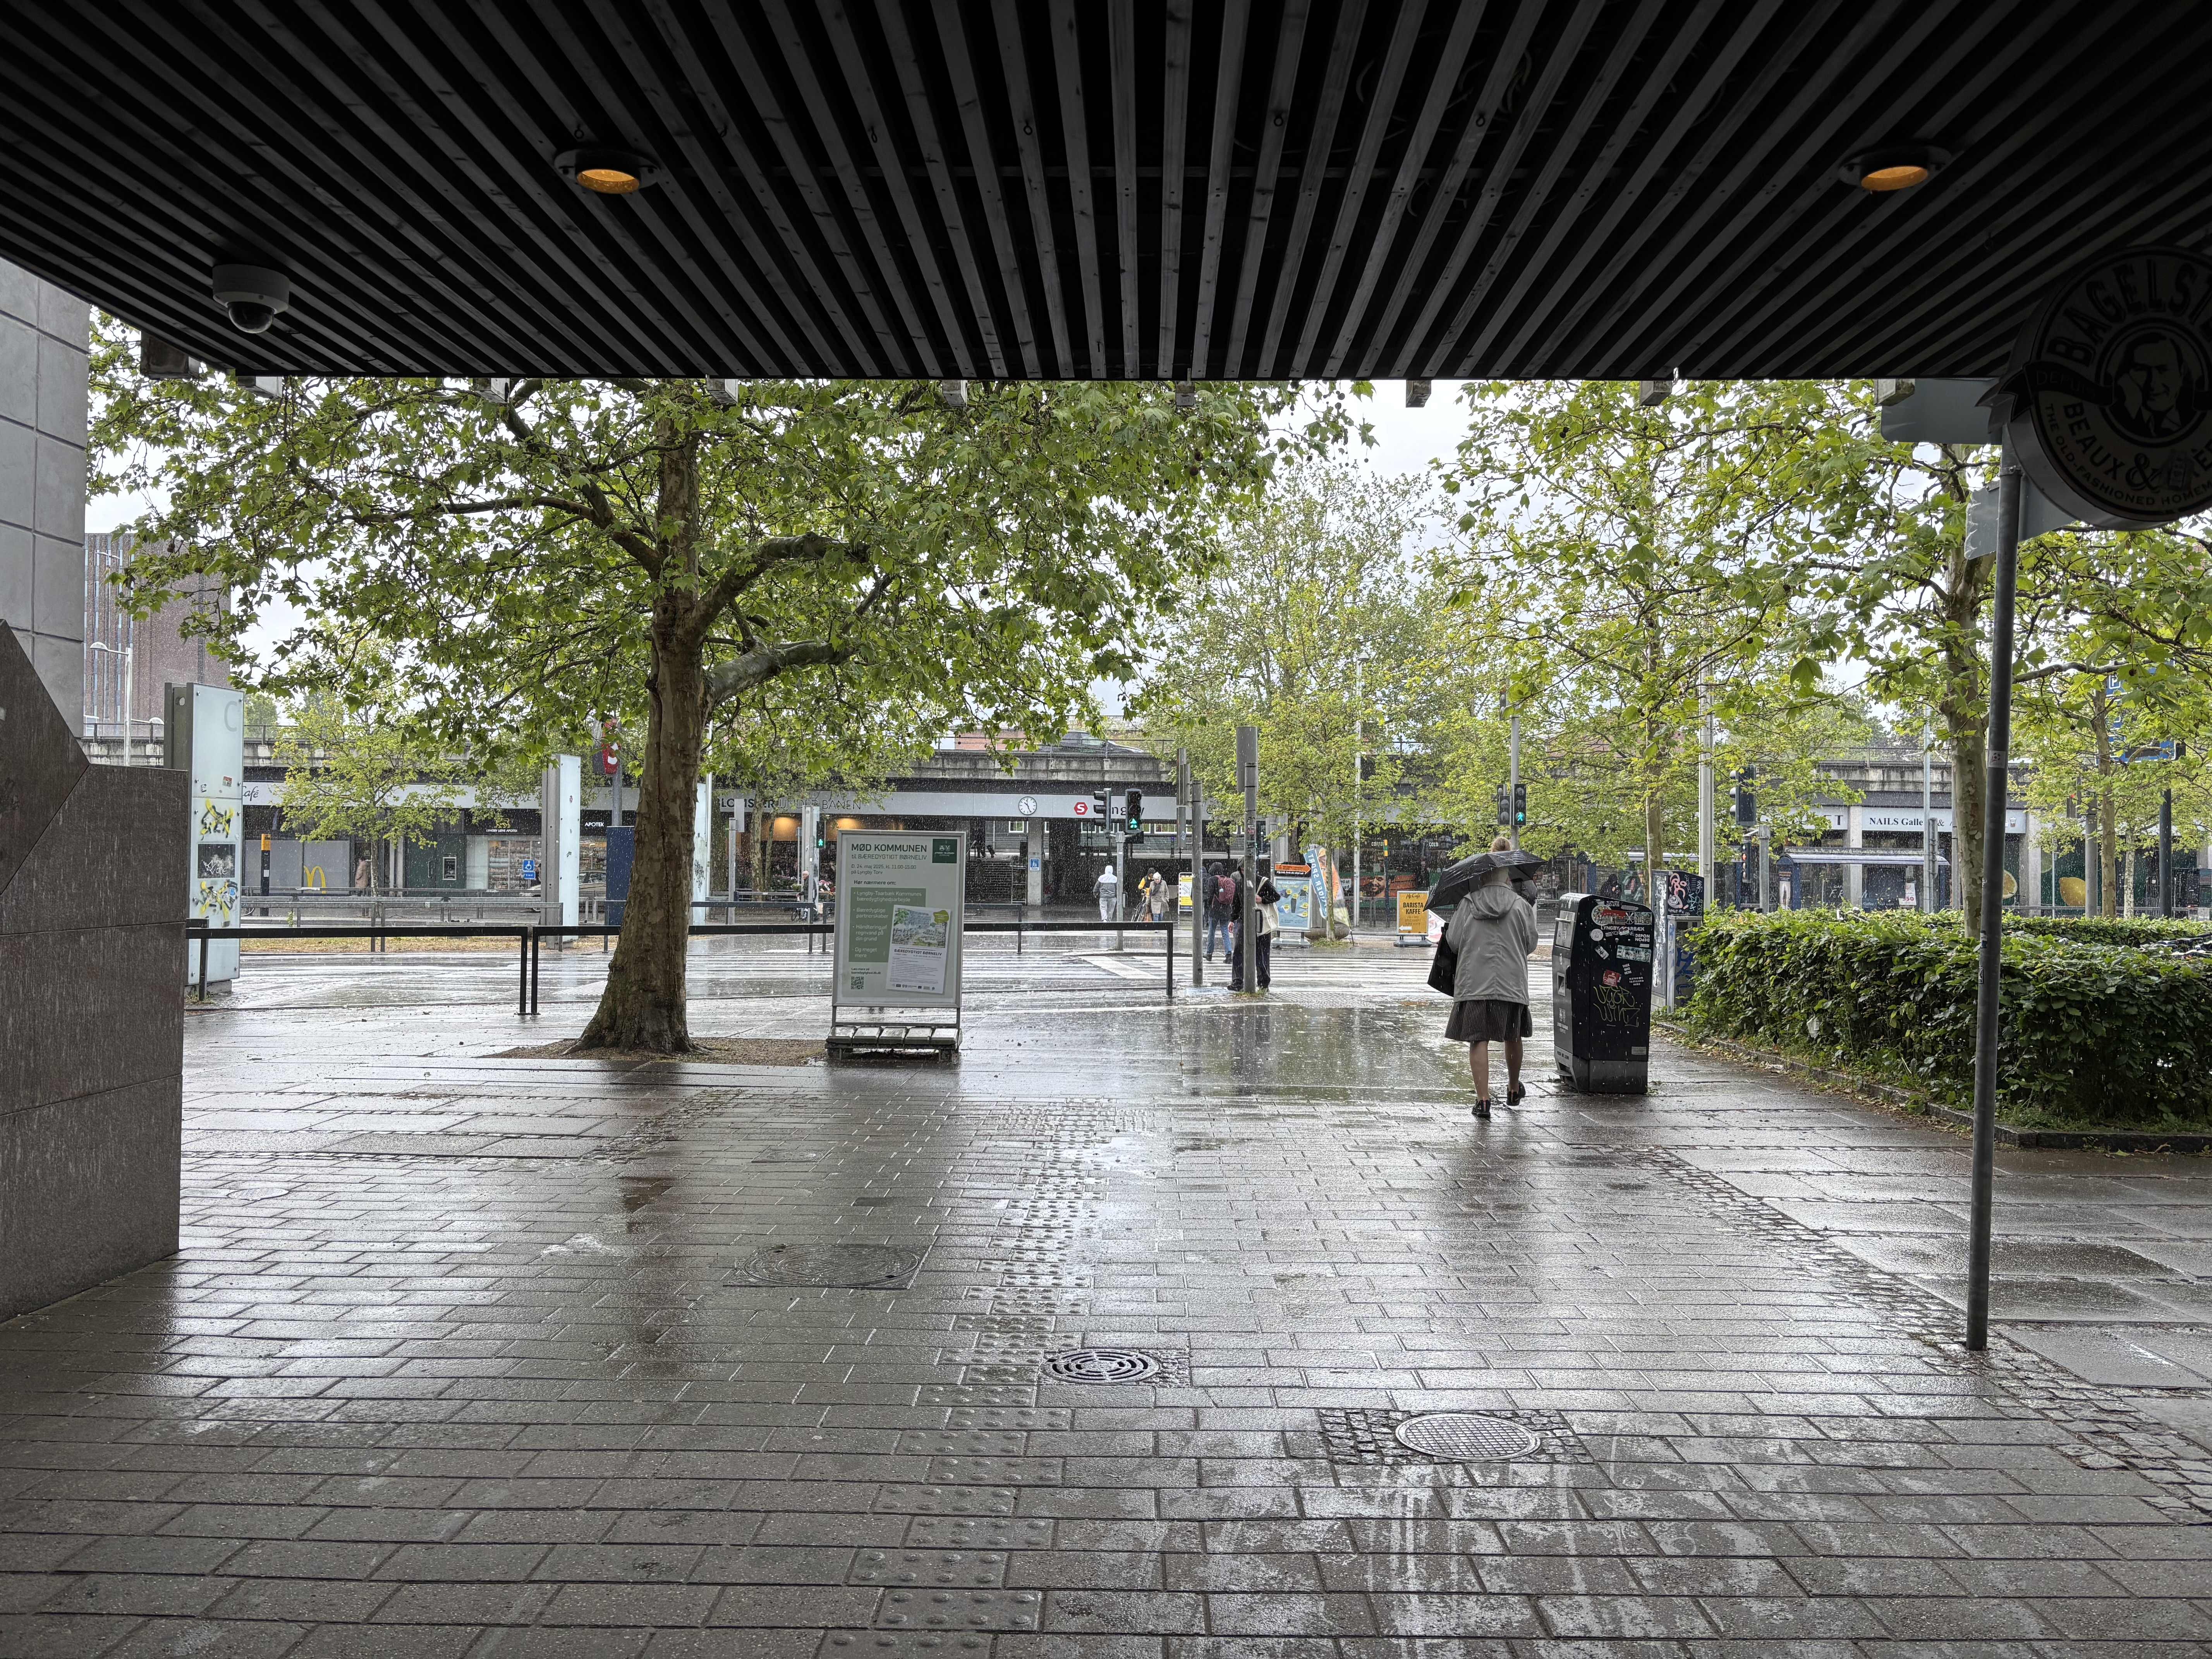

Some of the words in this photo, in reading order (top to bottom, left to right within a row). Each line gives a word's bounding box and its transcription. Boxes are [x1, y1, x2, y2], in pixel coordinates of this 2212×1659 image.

[2045, 404, 2059, 431] THE
[2056, 436, 2155, 506] OLD-FASHIONED
[2063, 402, 2126, 481] BEAUX
[224, 701, 237, 732] C
[1077, 804, 1085, 812] S
